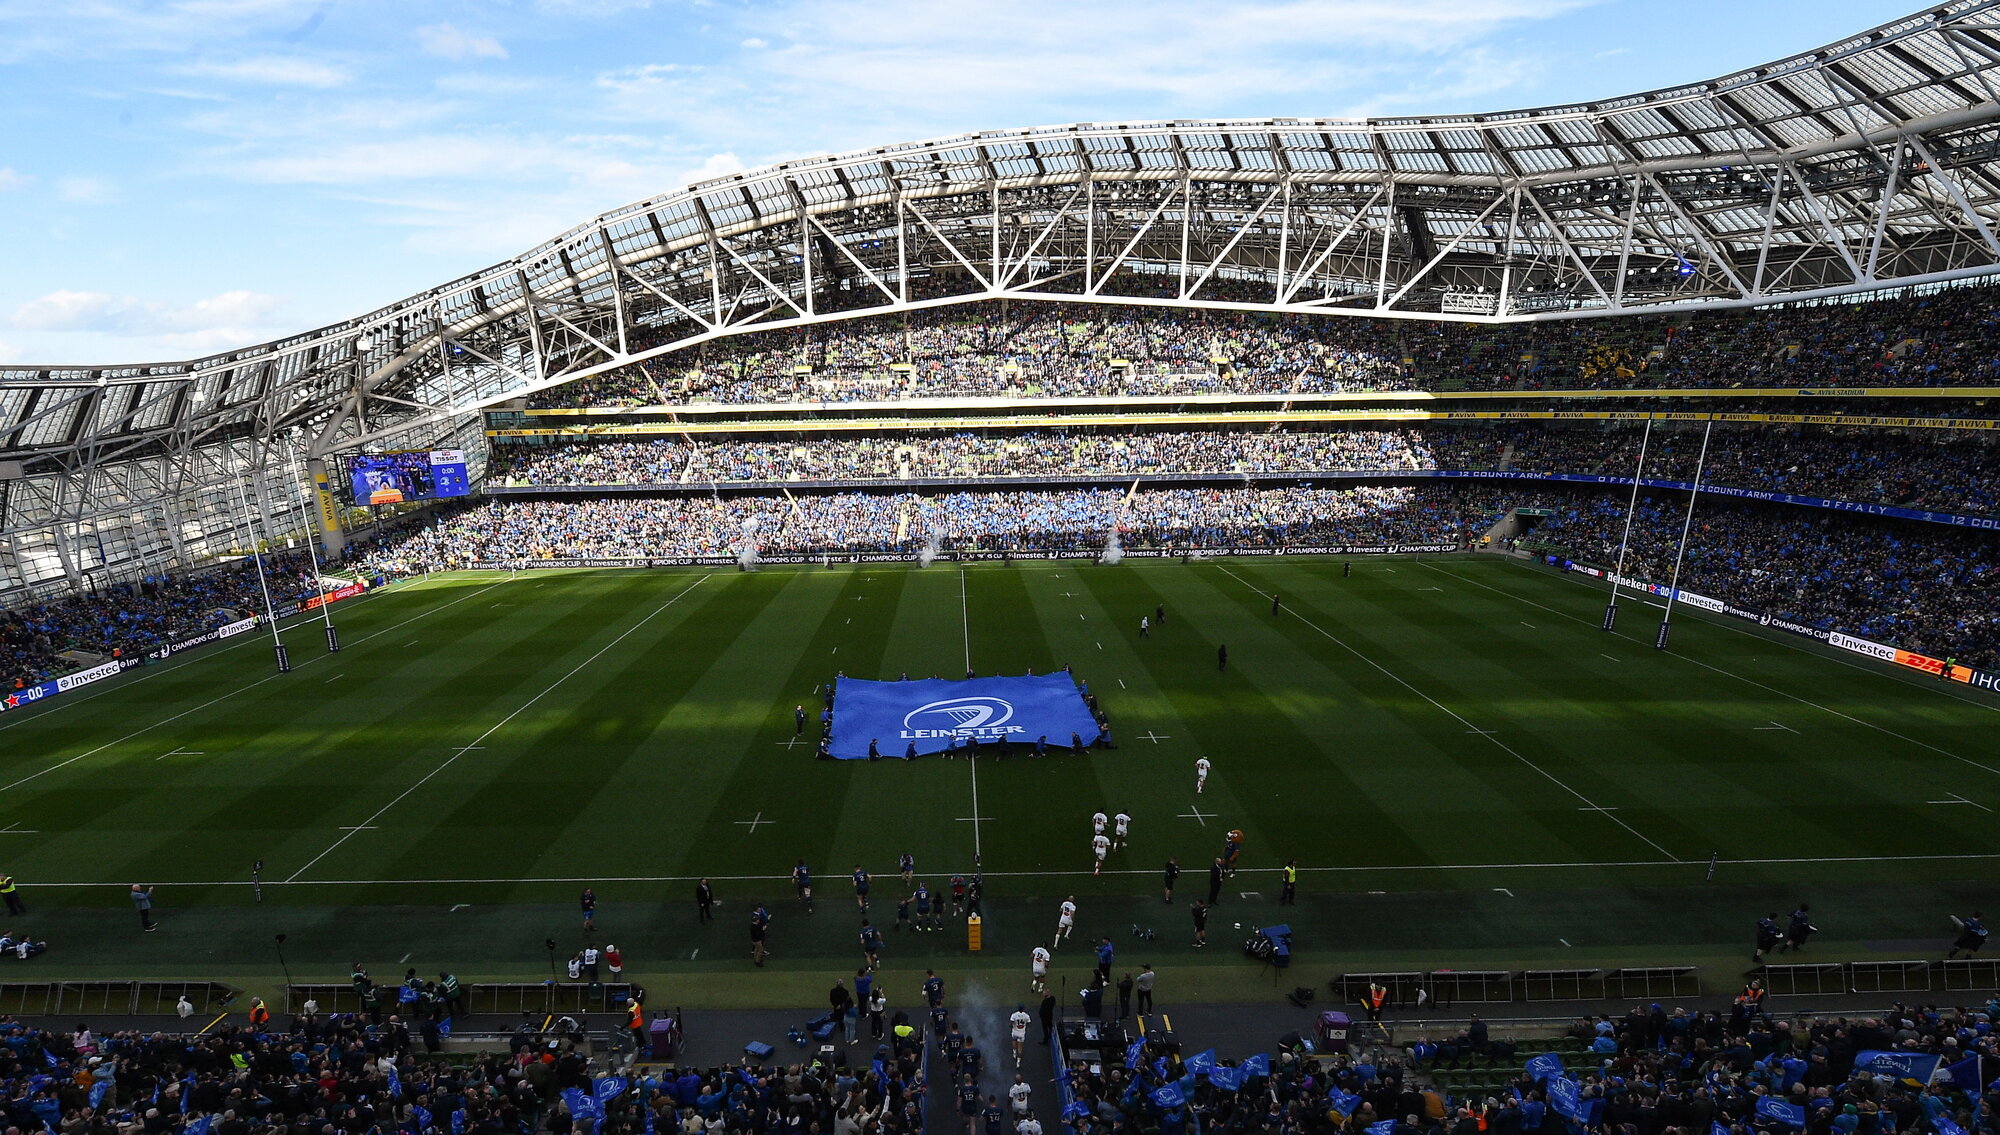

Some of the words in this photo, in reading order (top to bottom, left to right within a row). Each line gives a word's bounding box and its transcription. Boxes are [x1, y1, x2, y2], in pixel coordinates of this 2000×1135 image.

[1598, 476, 1654, 486] OFFALY
[1708, 485, 1745, 497] COUNTY
[1746, 490, 1774, 500] ARMY
[322, 495, 333, 520] AVIVA
[1822, 499, 1888, 514] OFFALY
[1951, 515, 1965, 524] 12
[1572, 564, 1587, 574] FINALS
[336, 590, 354, 599] Georgia
[1686, 594, 1722, 612] Investec
[280, 609, 298, 618] RESORTS
[1729, 606, 1759, 621] Investec
[1772, 618, 1813, 636] CHAMPIONS
[1814, 629, 1829, 640] CUP
[172, 634, 206, 652] CHAMPIONS
[207, 631, 220, 641] CUP
[1841, 636, 1894, 660] Investec
[70, 663, 118, 686] Investec
[900, 725, 1026, 739] LEINSTER
